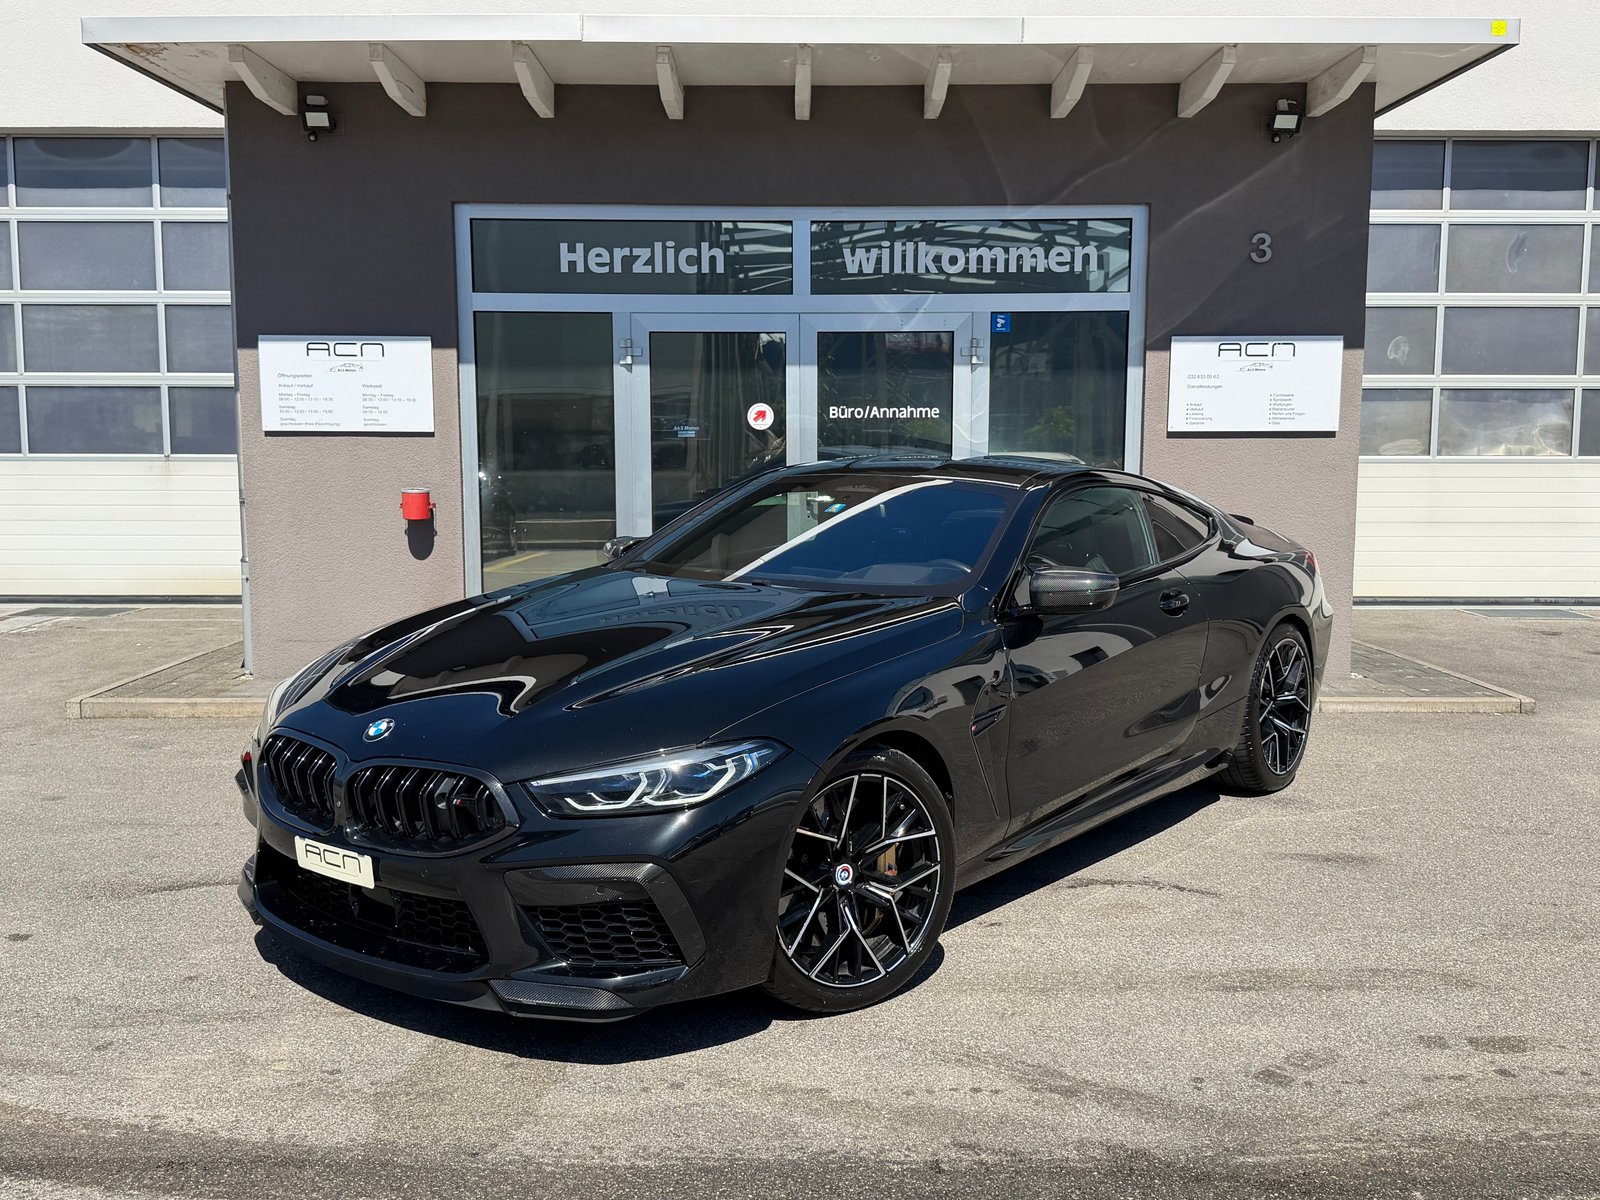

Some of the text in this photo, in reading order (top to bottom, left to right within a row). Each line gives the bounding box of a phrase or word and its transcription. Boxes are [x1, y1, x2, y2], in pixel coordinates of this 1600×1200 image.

[559, 240, 1098, 274] Herzlich willkommen
[1250, 232, 1272, 263] 3
[829, 405, 940, 419] Büro/Annahme
